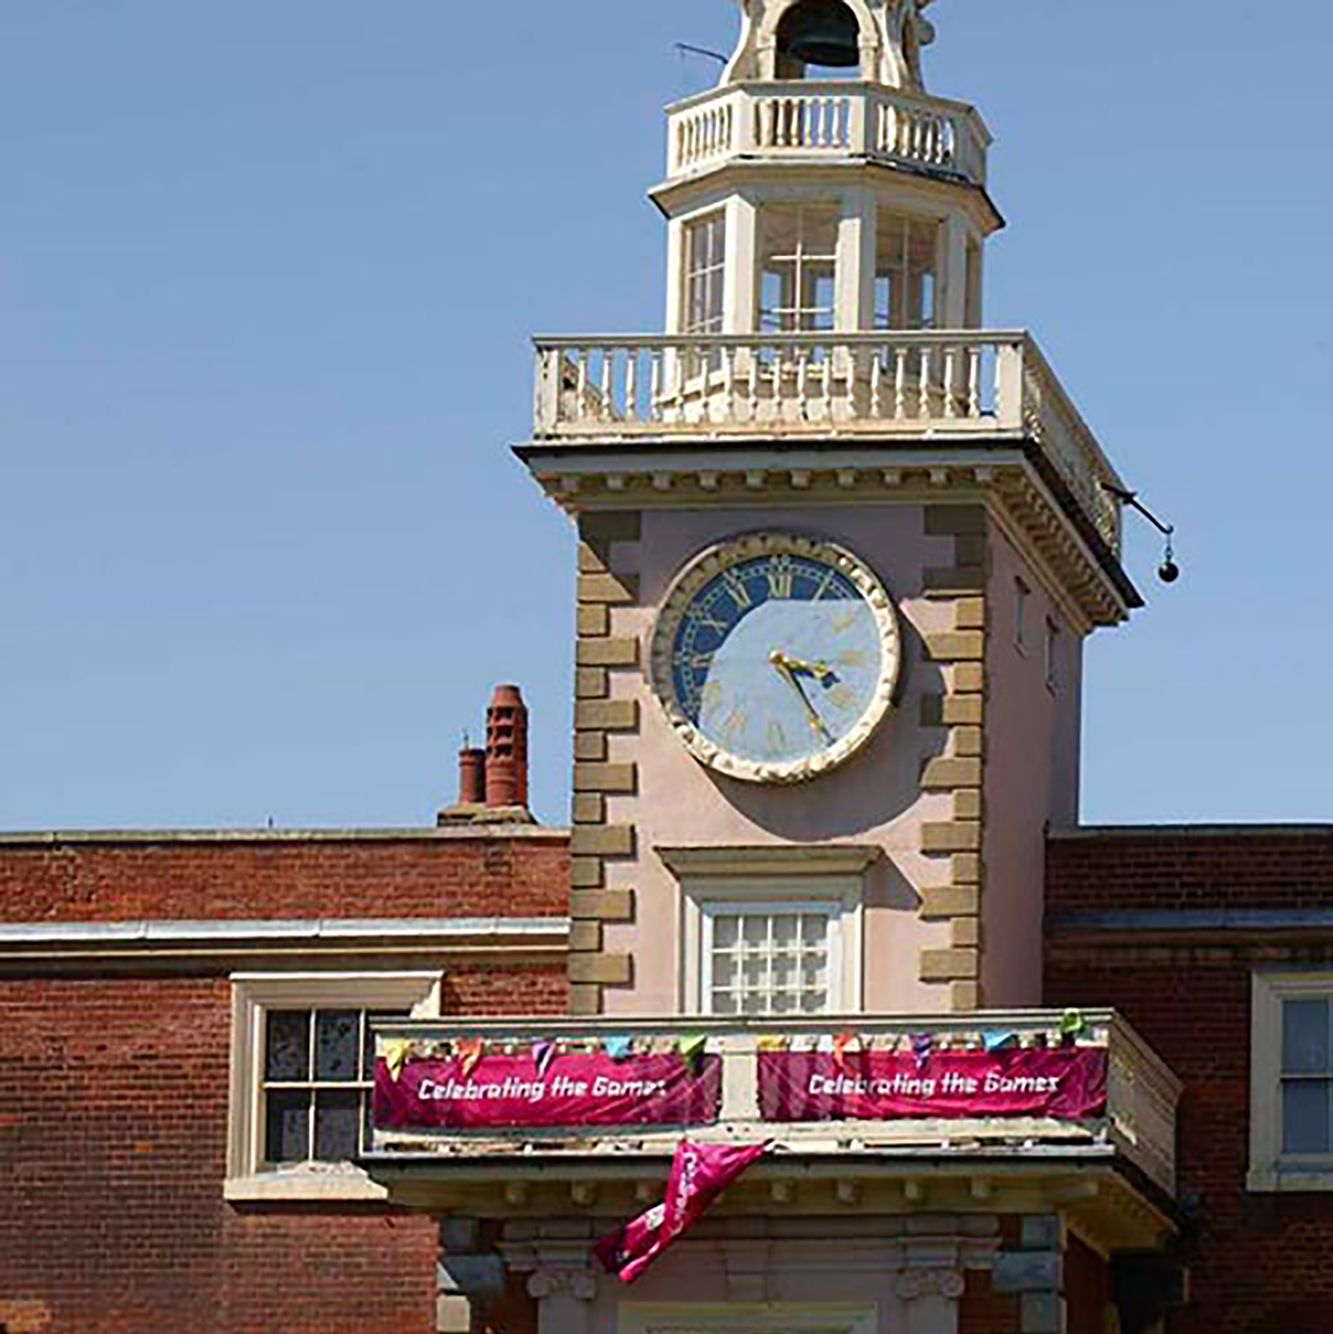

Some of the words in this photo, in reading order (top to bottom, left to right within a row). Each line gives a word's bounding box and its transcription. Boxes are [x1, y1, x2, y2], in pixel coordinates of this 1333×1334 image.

[418, 1077, 545, 1103] Celebrating
[551, 1075, 588, 1097] the
[808, 1072, 936, 1098] Celebrating
[941, 1071, 979, 1093] the
[983, 1071, 1060, 1094] Games
